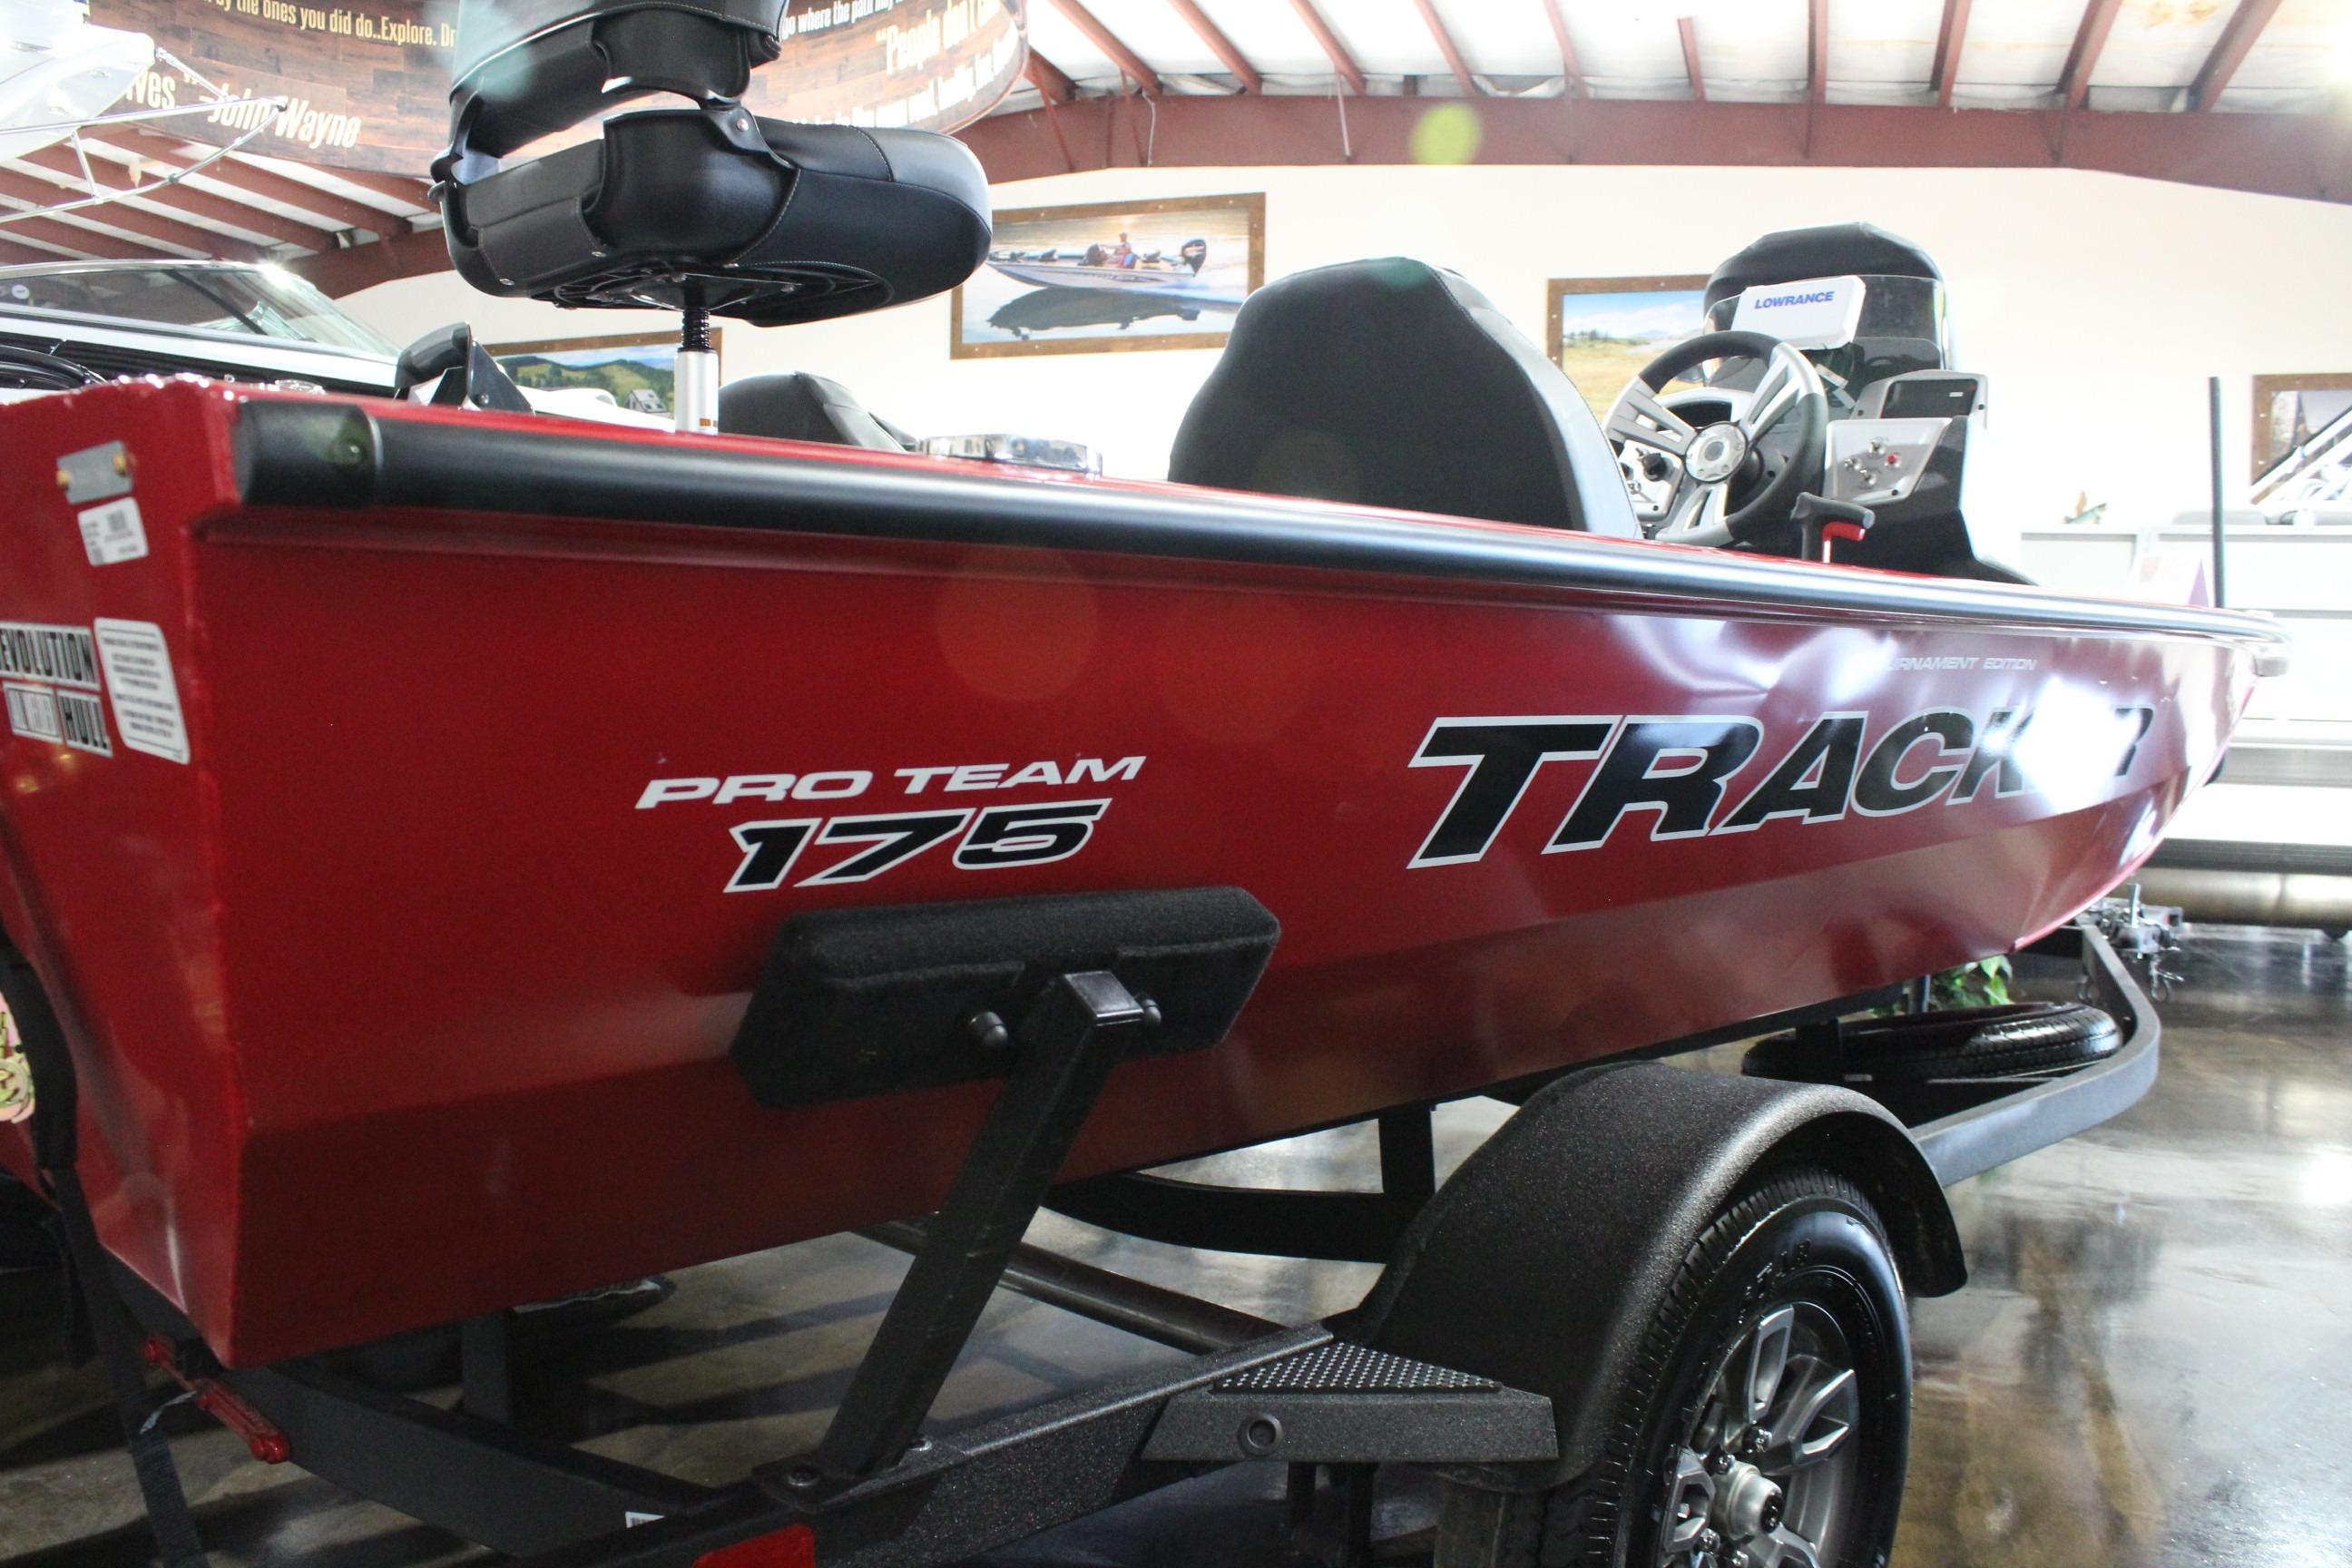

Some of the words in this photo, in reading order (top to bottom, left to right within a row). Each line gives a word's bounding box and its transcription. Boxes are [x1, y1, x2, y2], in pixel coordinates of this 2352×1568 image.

[262, 0, 297, 24] ones
[299, 7, 326, 30] you
[328, 8, 352, 35] did
[799, 7, 831, 34] where
[833, 0, 849, 25] the
[274, 96, 362, 151] Wayne
[1754, 290, 1836, 309] LOWRANCE
[1982, 657, 2038, 671] EDITION
[634, 769, 873, 810] PRO
[894, 755, 1147, 795] TEAM
[1407, 702, 2155, 868] TRACKR
[722, 798, 1113, 894] 175
